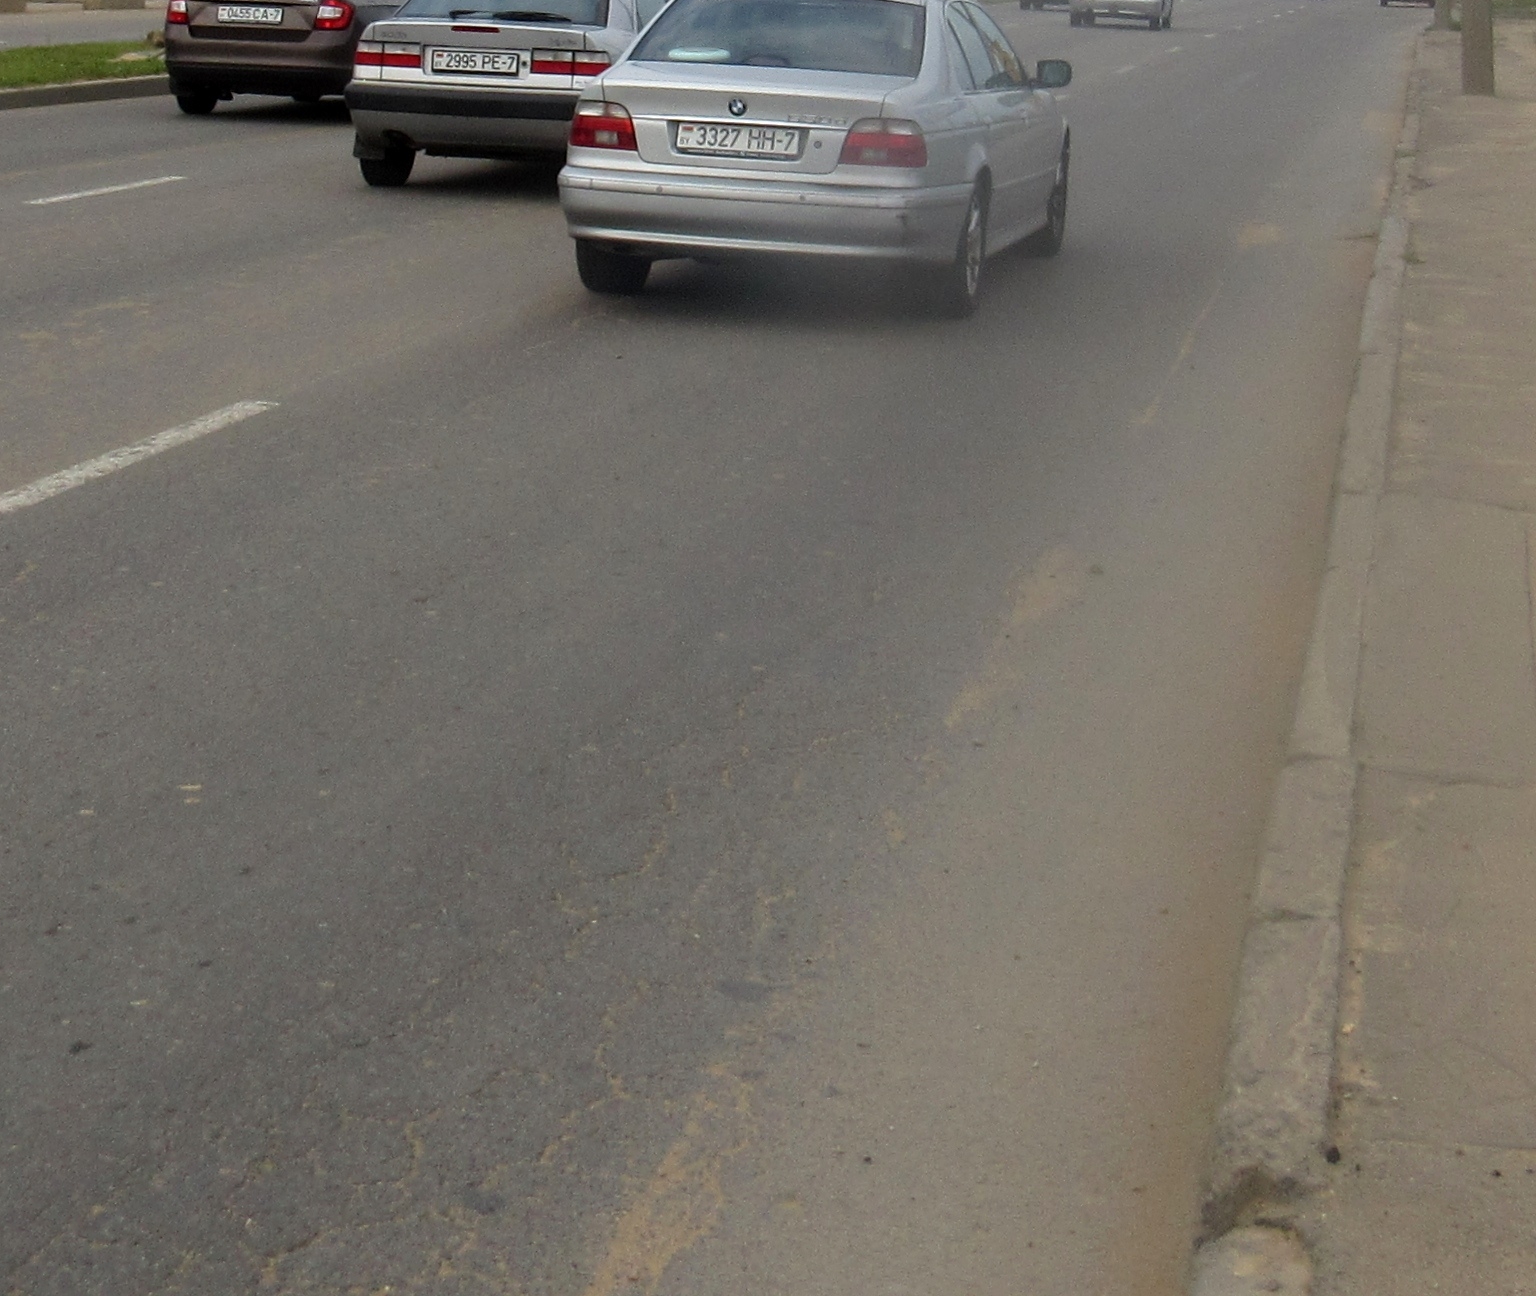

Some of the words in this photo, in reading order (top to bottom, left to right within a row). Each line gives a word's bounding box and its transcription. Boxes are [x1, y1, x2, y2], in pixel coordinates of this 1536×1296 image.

[252, 7, 280, 21] CA-7
[445, 54, 477, 69] 2995
[481, 55, 516, 71] PE-7
[695, 125, 742, 149] 3327
[747, 129, 796, 151] HH-7
